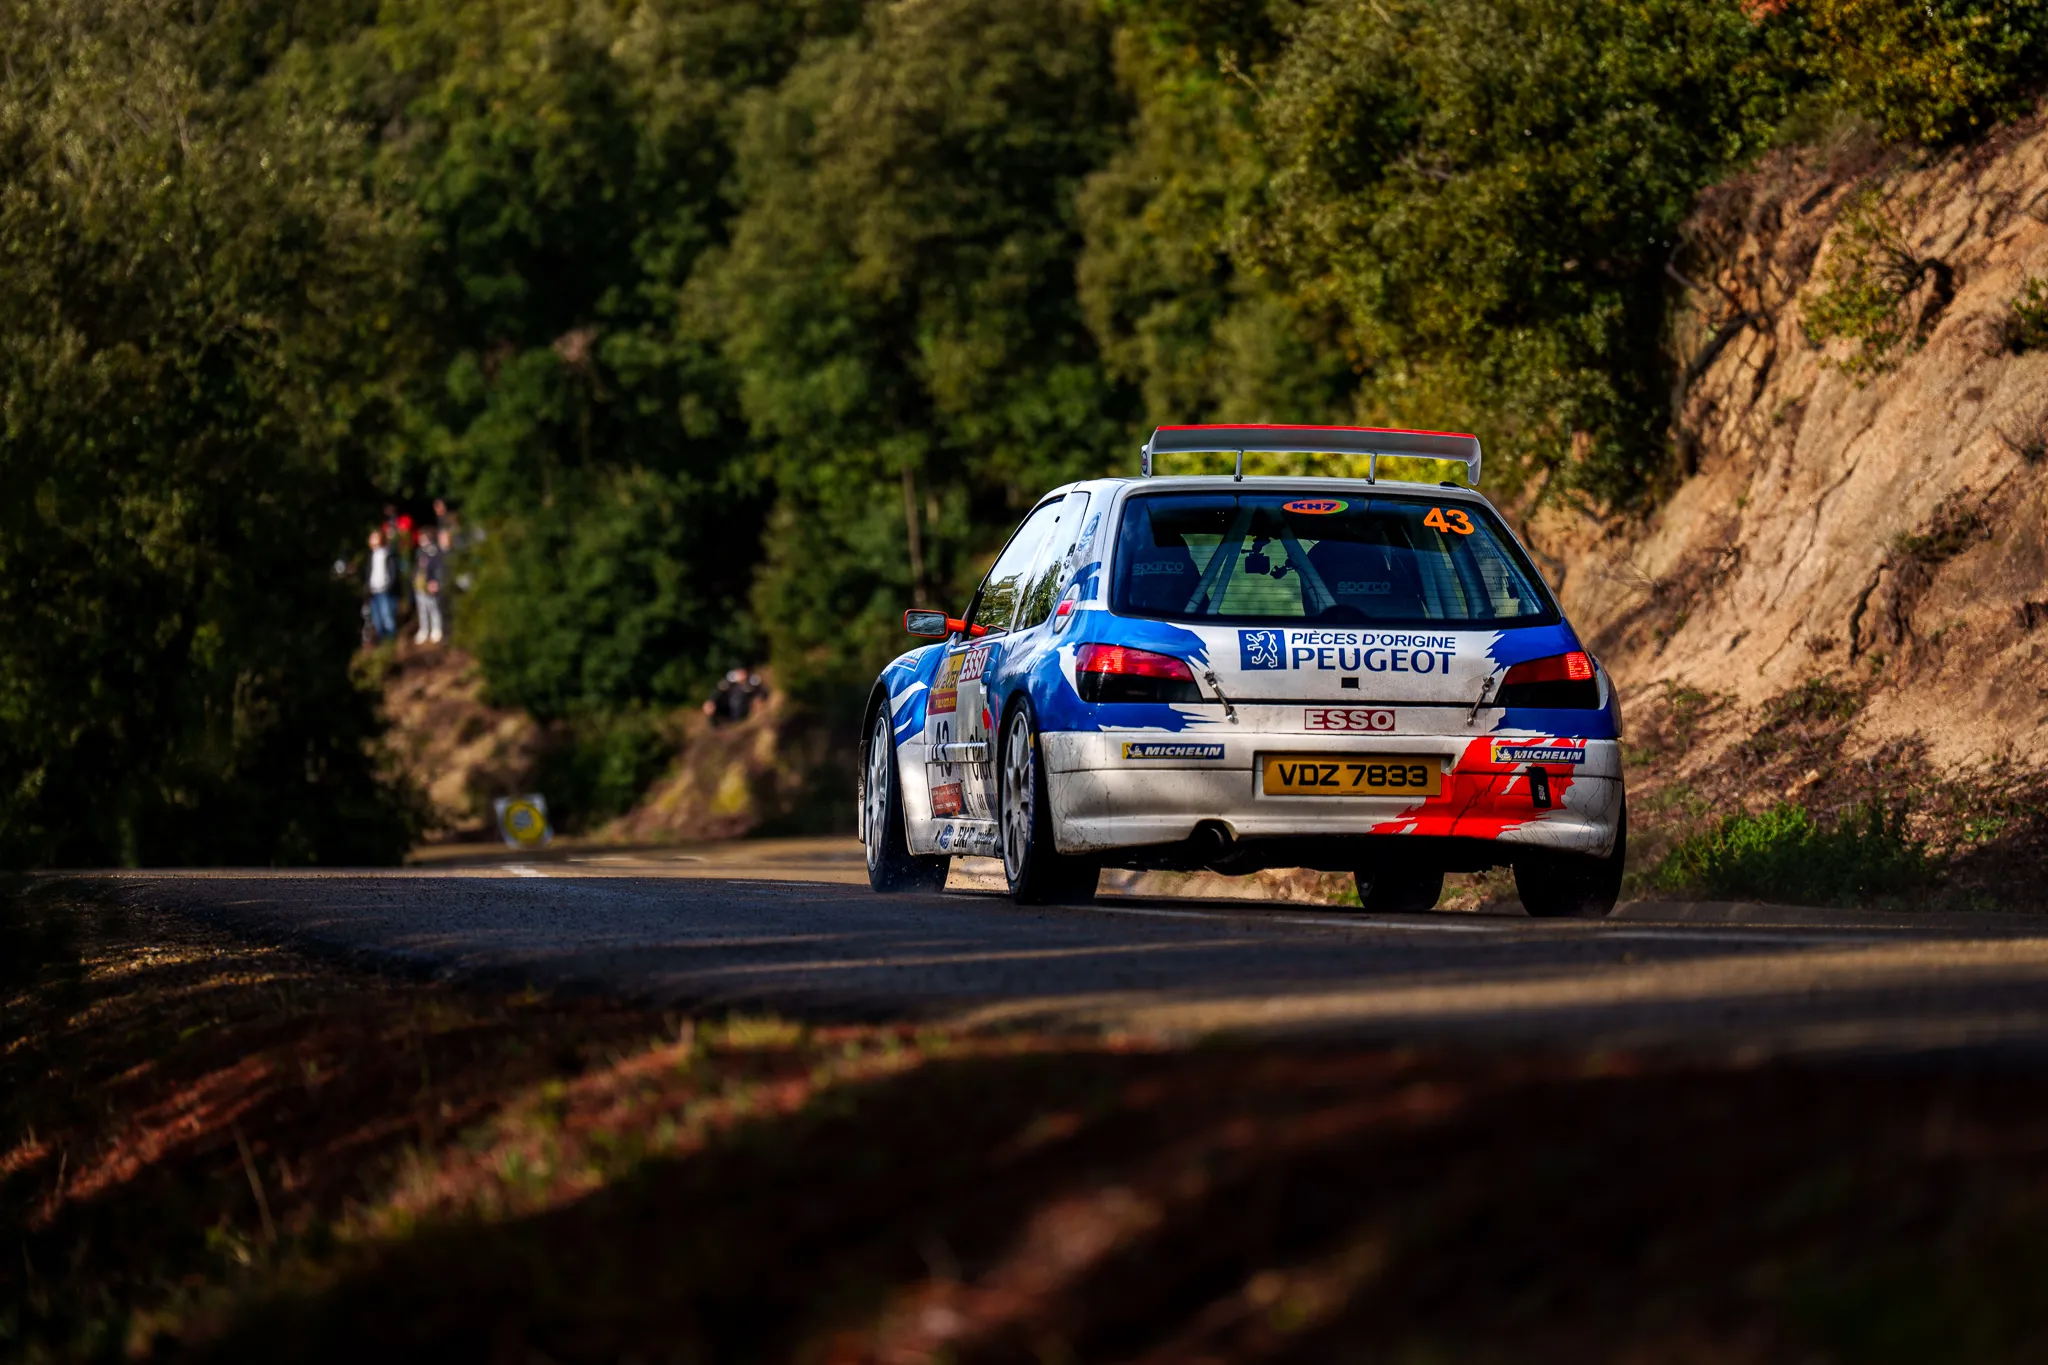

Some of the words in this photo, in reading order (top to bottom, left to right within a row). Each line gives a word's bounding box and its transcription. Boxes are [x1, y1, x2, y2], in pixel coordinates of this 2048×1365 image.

[1423, 507, 1475, 536] 43
[1132, 561, 1185, 576] sparco
[1337, 581, 1391, 595] sparco
[1291, 631, 1358, 645] PIÈCES
[1362, 633, 1456, 649] D'ORIGINE
[960, 648, 990, 681] ESSO
[1292, 647, 1456, 674] PEUGEOT
[1306, 710, 1394, 730] ESSO
[1144, 746, 1221, 756] MICHELIN
[1513, 750, 1583, 760] MICHELIN
[1278, 764, 1340, 787] VDZ
[1346, 764, 1428, 787] 7833
